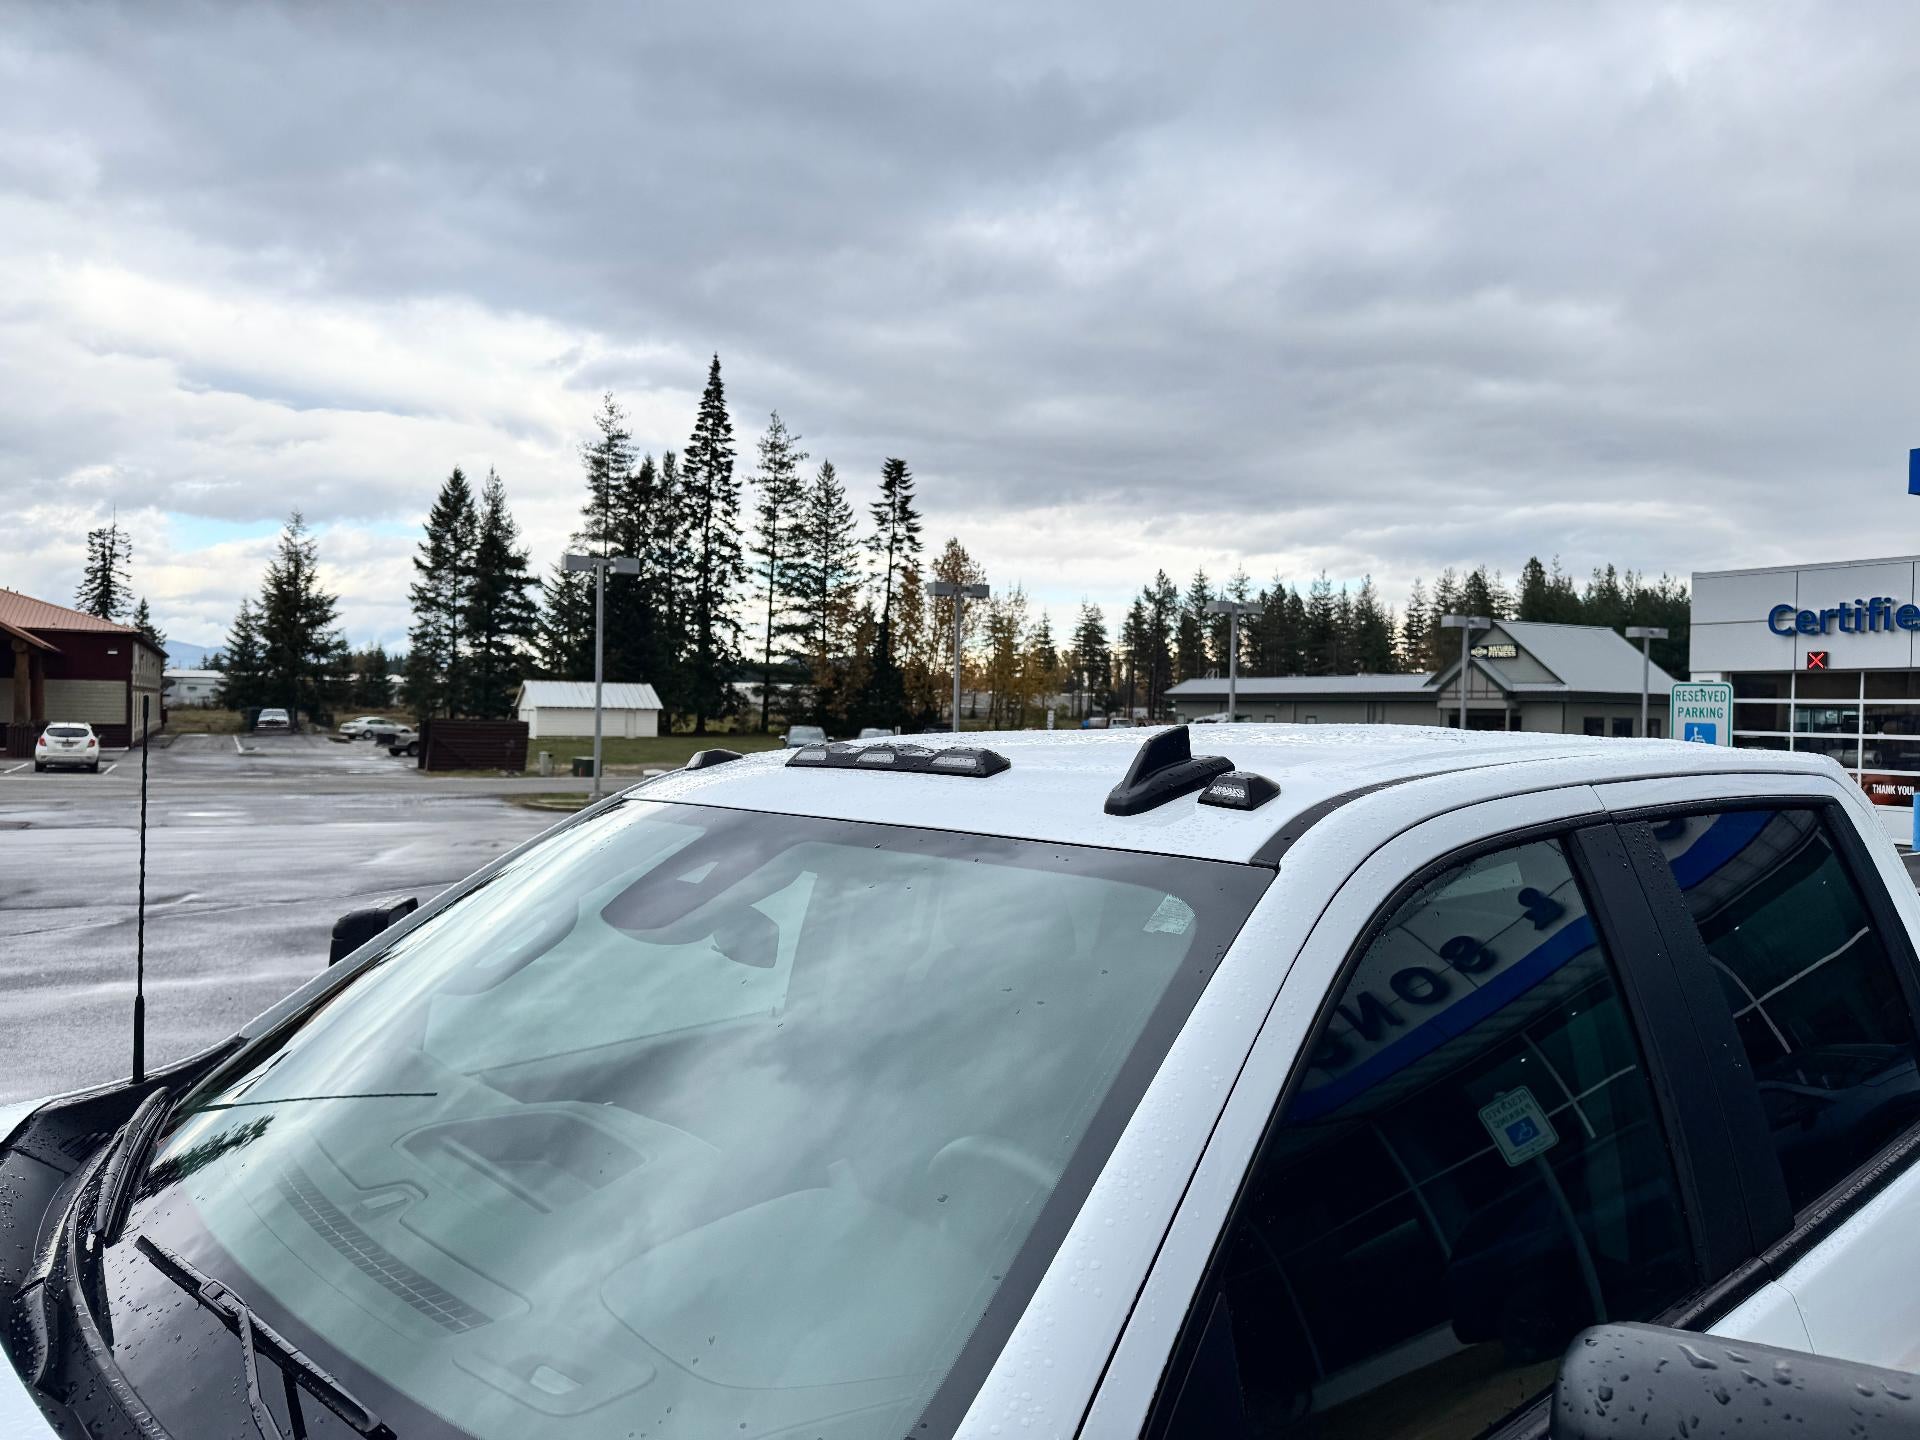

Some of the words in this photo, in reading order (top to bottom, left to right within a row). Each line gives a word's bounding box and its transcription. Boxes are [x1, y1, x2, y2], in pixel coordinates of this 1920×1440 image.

[1675, 690, 1727, 703] RESERVED
[1677, 706, 1724, 719] PARKING
[1872, 784, 1896, 794] THANK
[1897, 785, 1915, 796] YOU!
